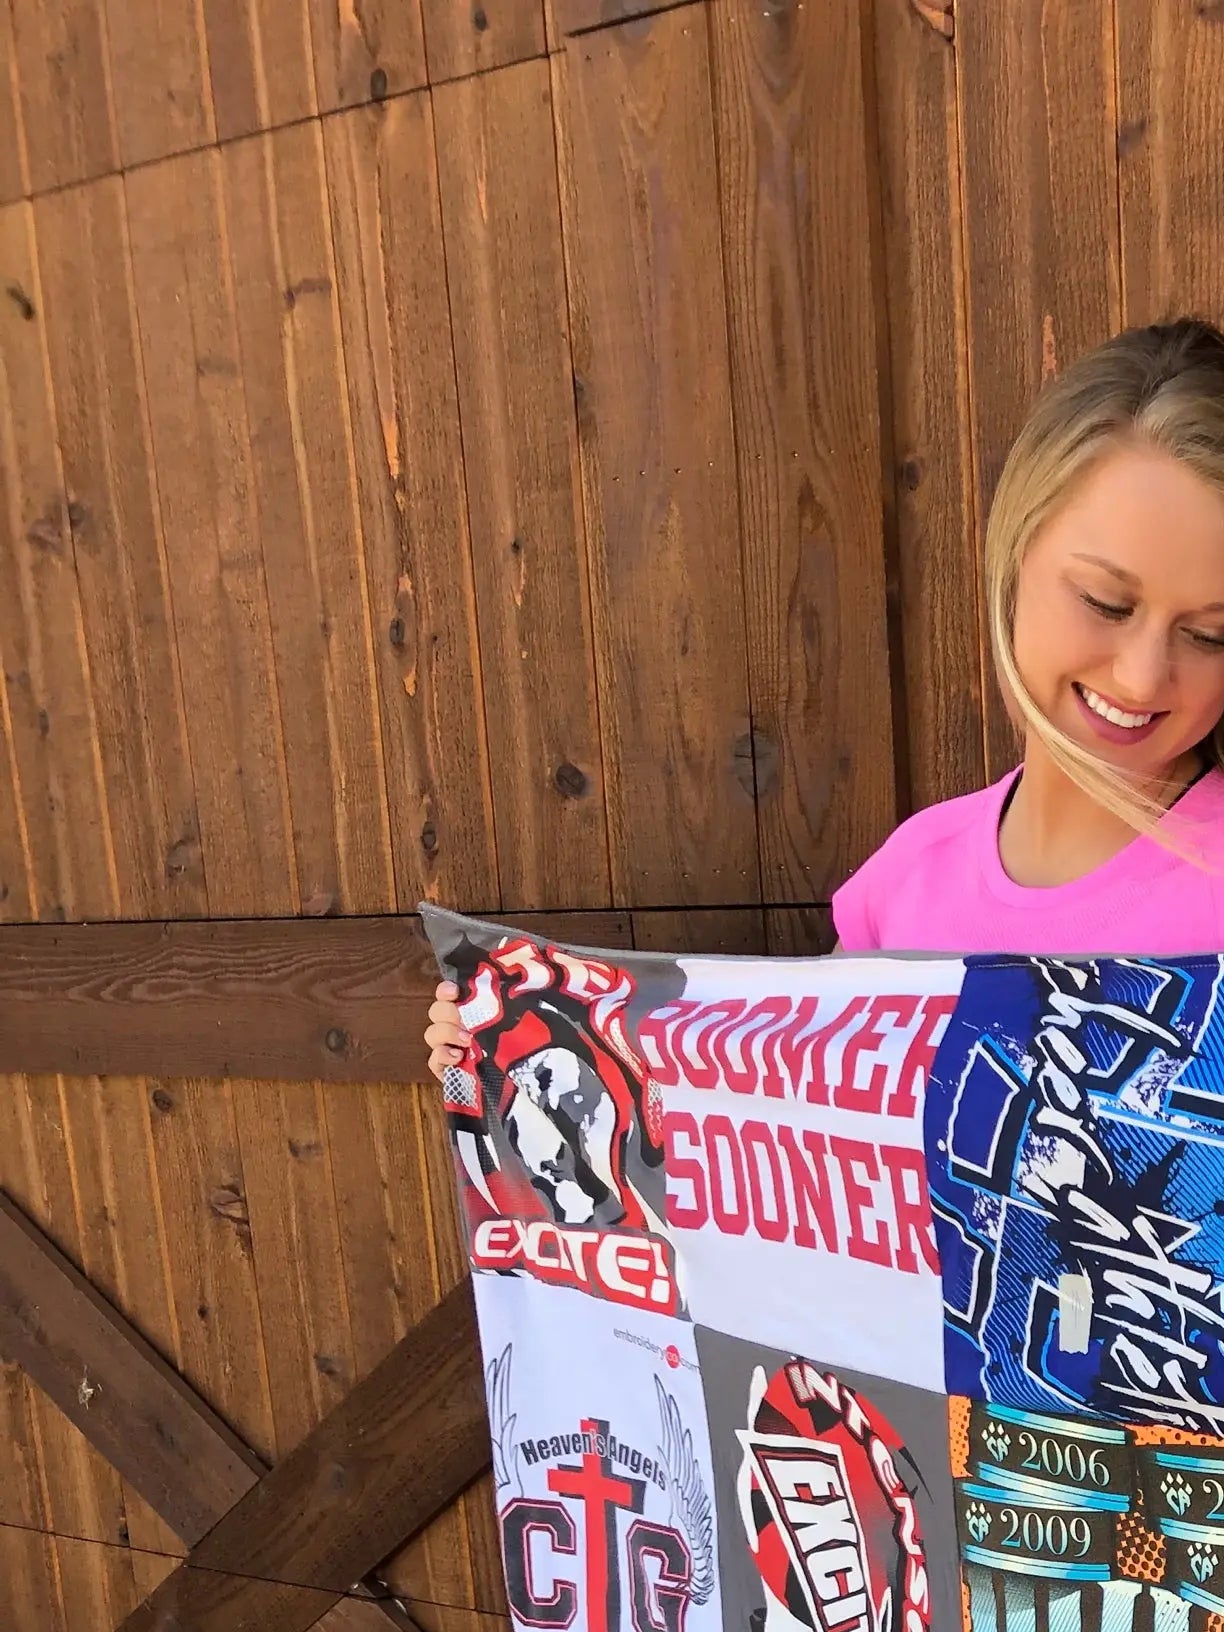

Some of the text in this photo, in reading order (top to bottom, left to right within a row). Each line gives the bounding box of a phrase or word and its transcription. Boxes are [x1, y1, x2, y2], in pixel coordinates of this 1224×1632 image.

[637, 994, 957, 1117] BOOMER
[665, 1112, 942, 1275] SOONER
[520, 1430, 668, 1492] Heaven's Angels
[1018, 1432, 1110, 1487] 2006
[1000, 1508, 1091, 1557] 2009
